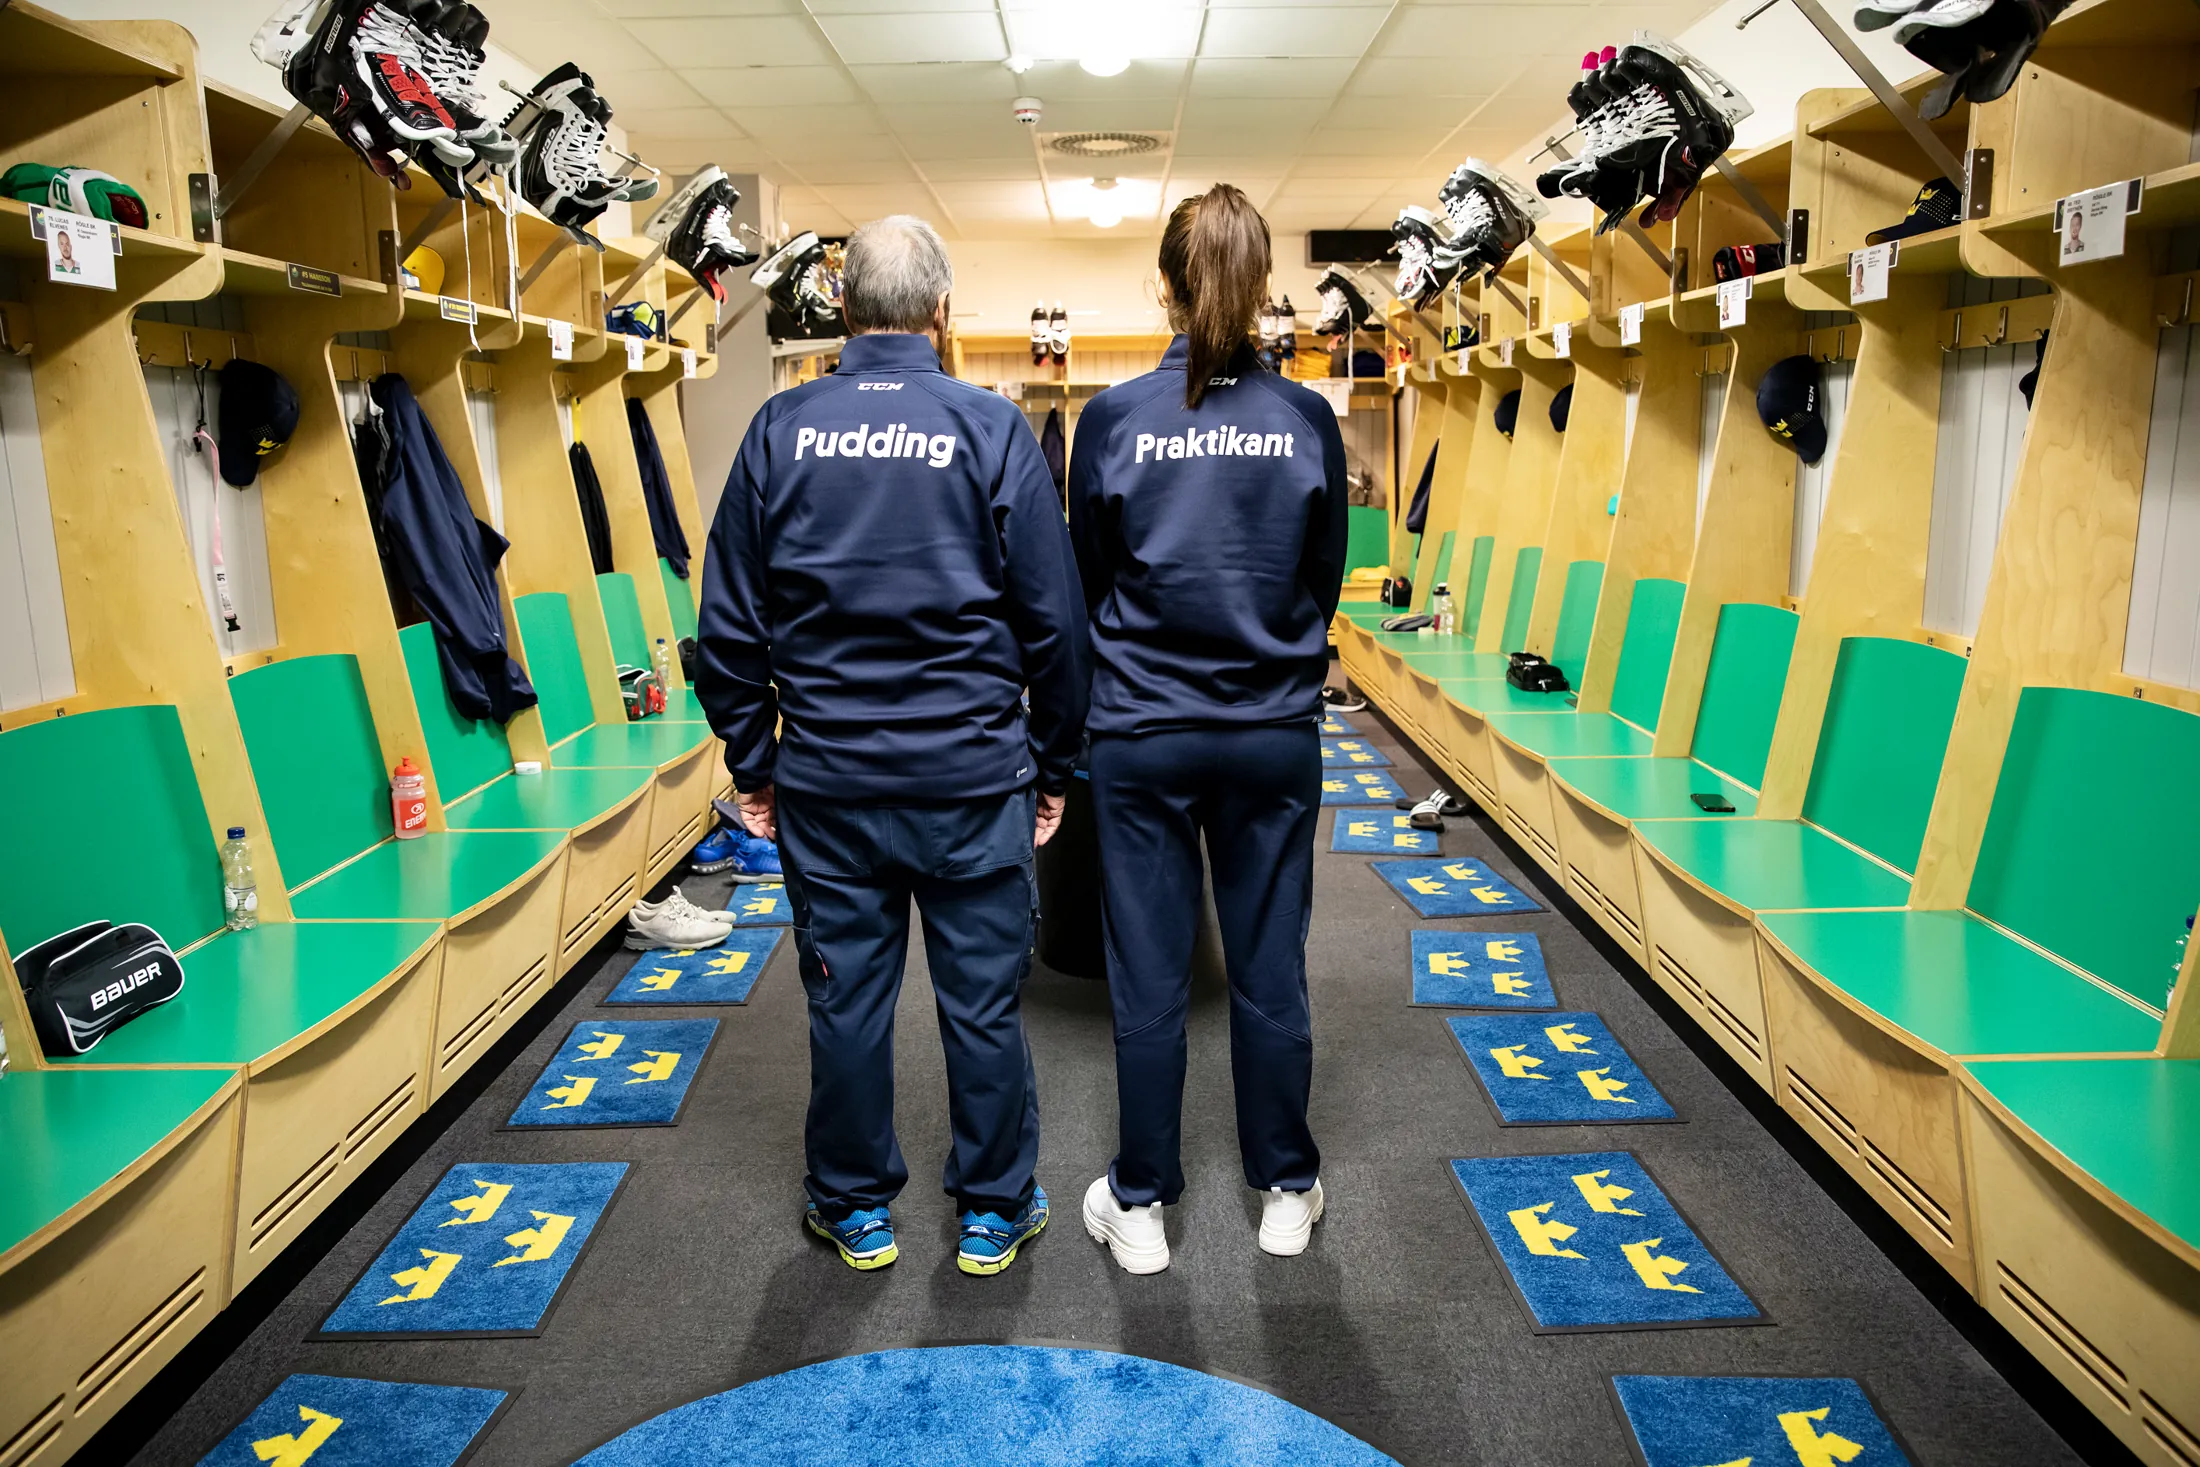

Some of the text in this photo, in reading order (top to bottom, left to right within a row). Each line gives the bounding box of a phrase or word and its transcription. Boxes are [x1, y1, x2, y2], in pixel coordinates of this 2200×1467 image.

[326, 15, 342, 51] BAUER
[540, 128, 556, 160] CCM
[857, 382, 905, 391] CCM
[1208, 377, 1238, 386] CM
[1806, 385, 1815, 412] CCM
[794, 423, 956, 469] Pudding
[1135, 424, 1294, 464] Praktikant
[90, 961, 162, 1012] BAUER
